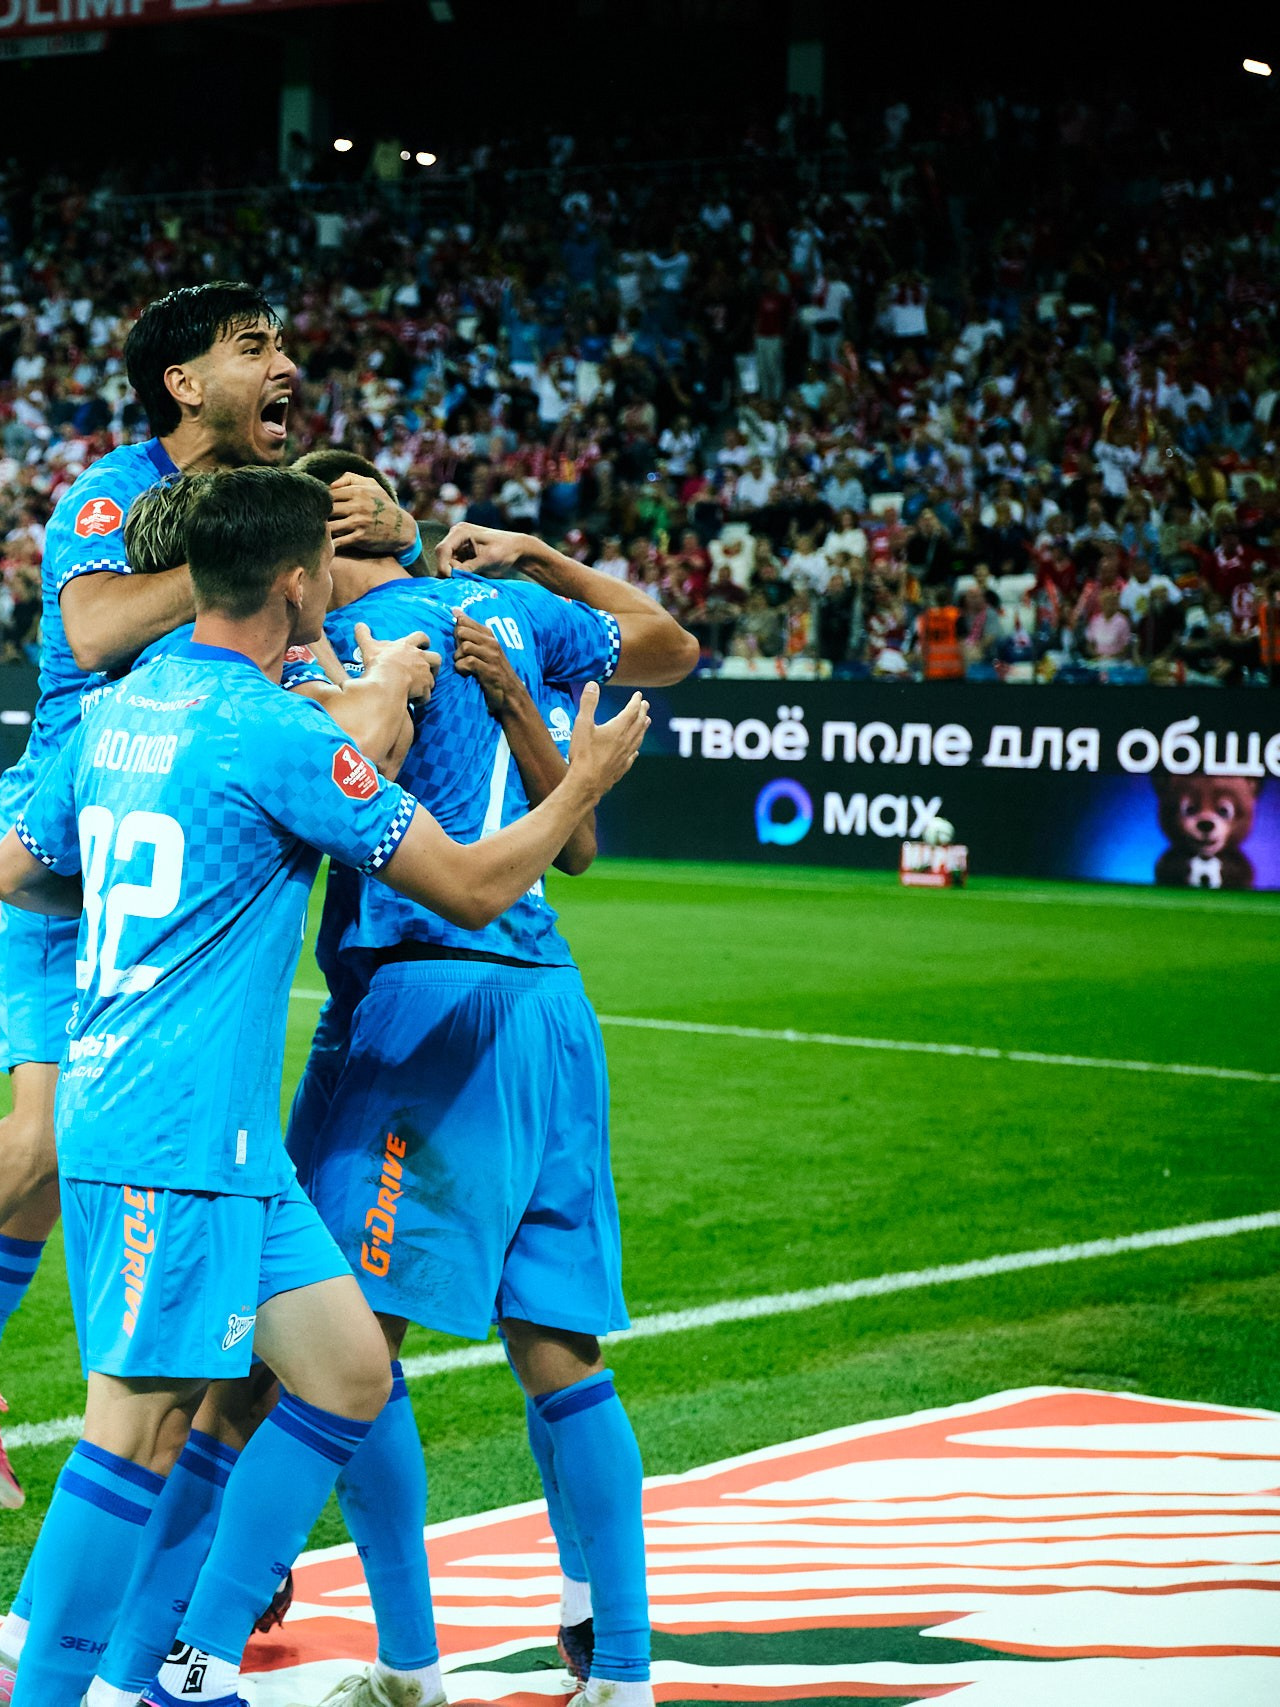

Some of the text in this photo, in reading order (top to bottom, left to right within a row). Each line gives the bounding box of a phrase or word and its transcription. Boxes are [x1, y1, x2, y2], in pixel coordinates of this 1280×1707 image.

[93, 728, 179, 775] ВОЛКОВ
[669, 705, 810, 761] твоё
[822, 720, 973, 767] поле
[982, 725, 1100, 772] для
